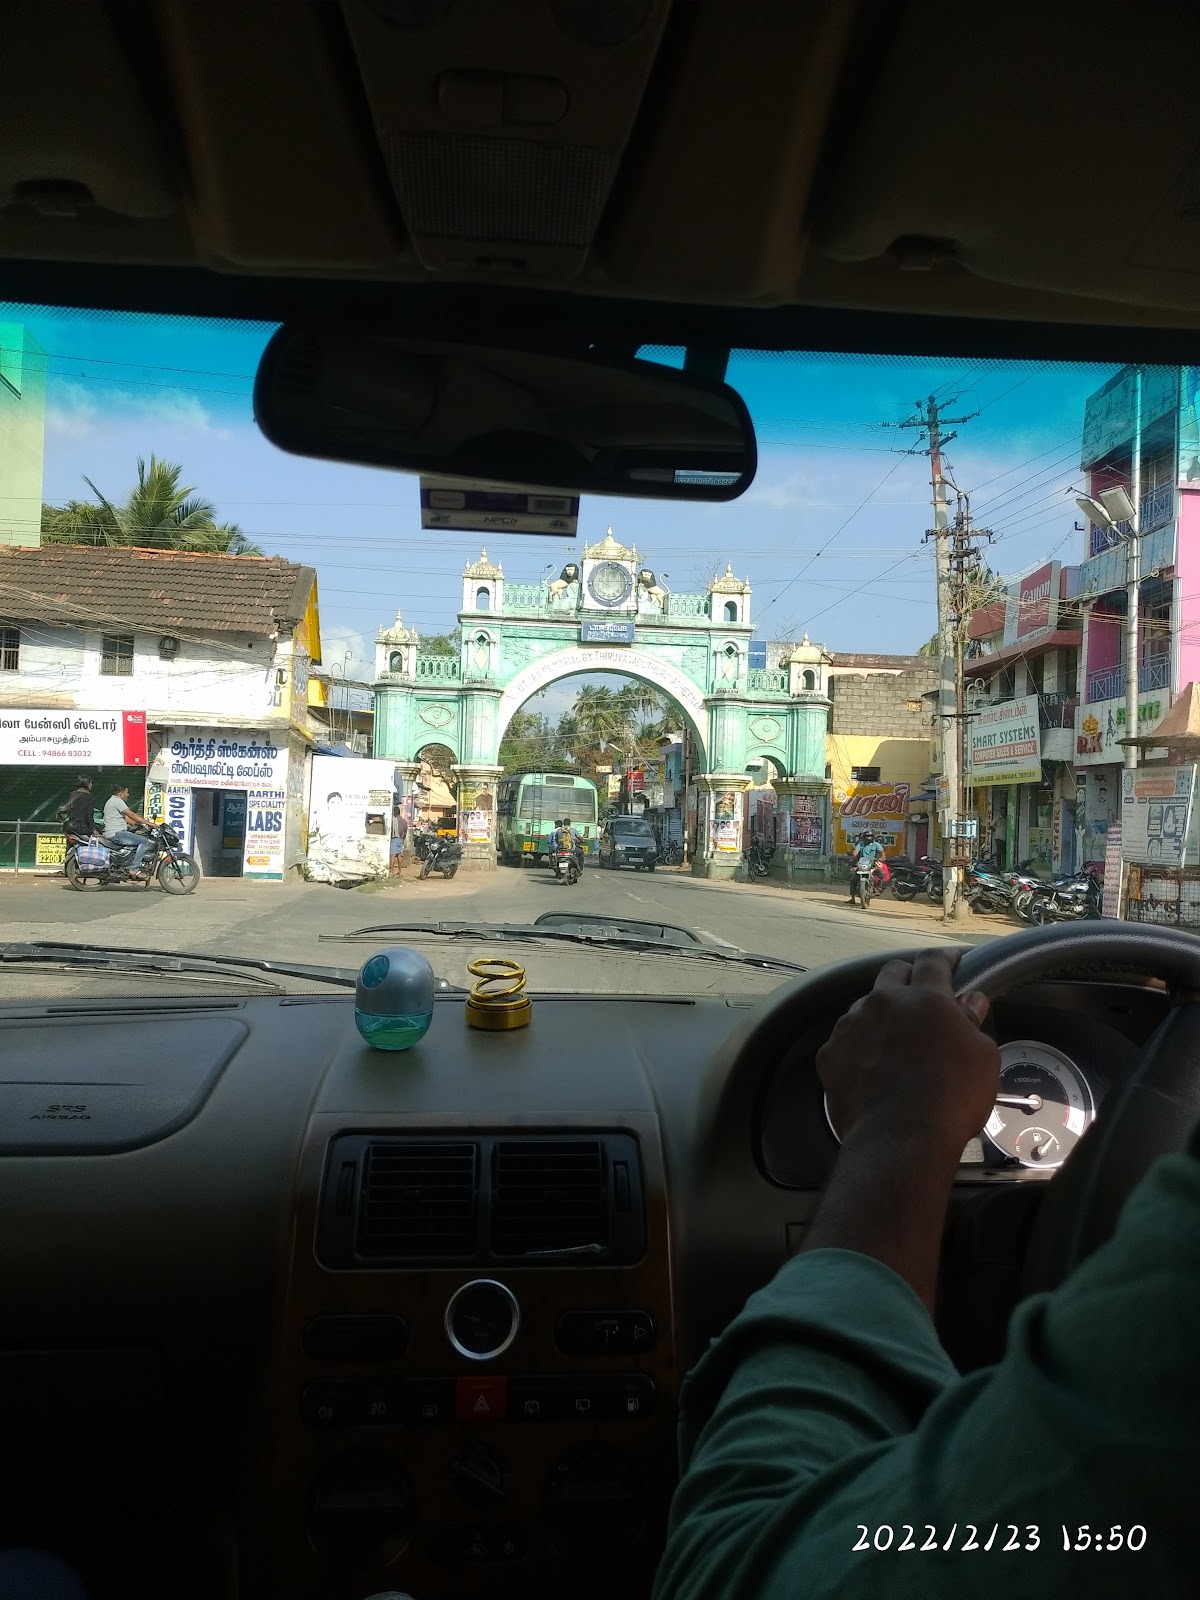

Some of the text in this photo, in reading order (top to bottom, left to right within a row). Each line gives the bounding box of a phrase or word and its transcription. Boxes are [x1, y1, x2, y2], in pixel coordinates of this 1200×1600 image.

[1022, 580, 1050, 606] Canon
[582, 653, 592, 662] BY
[25, 717, 71, 729] பேன்ஸி
[74, 718, 117, 732] ஸ்டோர்
[19, 735, 90, 745] அம்பாசமுத்திரம்
[972, 725, 1036, 748] SMART SYSTEMS
[217, 739, 278, 759] ஸ்கேன்ஸ்
[171, 760, 273, 779] ஸ்பெஷாலிட்டி லேப்ஸ்
[168, 786, 191, 794] AARTHI
[249, 790, 285, 798] AARTHI
[249, 800, 285, 808] SPECIALITY
[839, 784, 908, 818] பரணி
[248, 810, 282, 832] LABS
[851, 818, 887, 829] சைவம்
